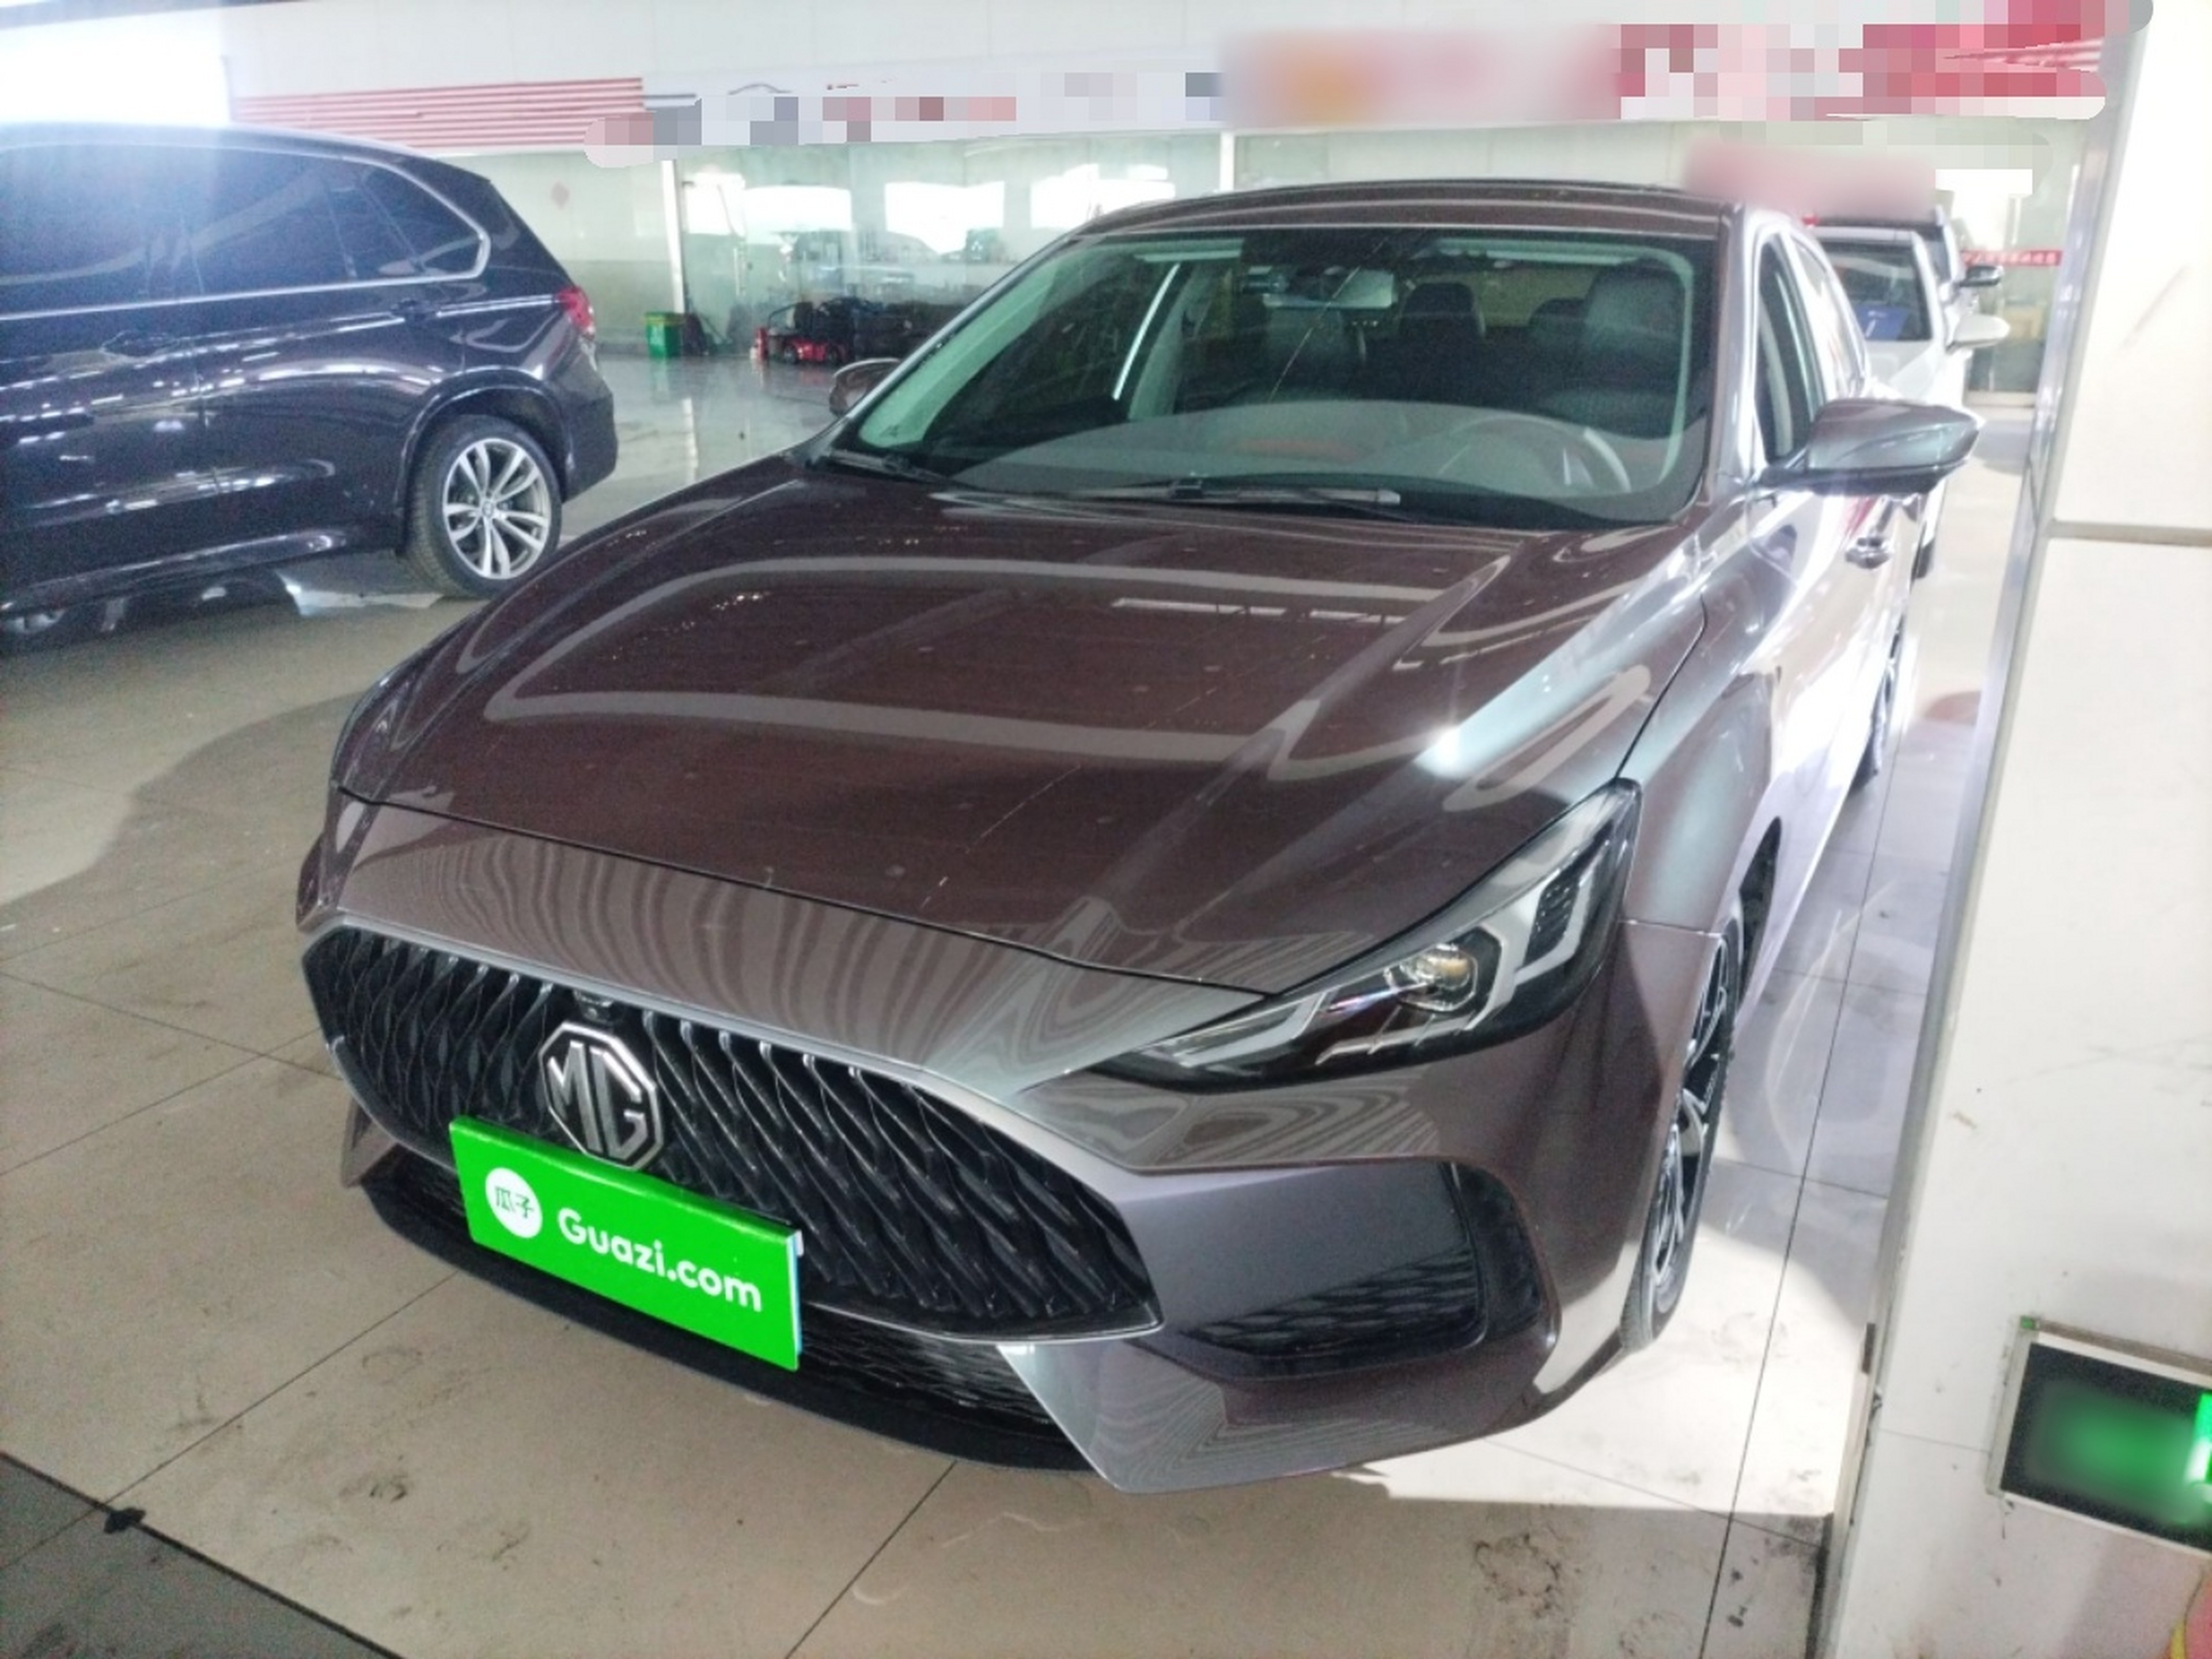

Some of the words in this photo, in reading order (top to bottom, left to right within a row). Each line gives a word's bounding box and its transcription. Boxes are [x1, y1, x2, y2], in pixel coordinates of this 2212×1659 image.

[548, 1040, 648, 1161] MG
[495, 1186, 535, 1218] 瓜子
[558, 1207, 762, 1312] Guazi.com
